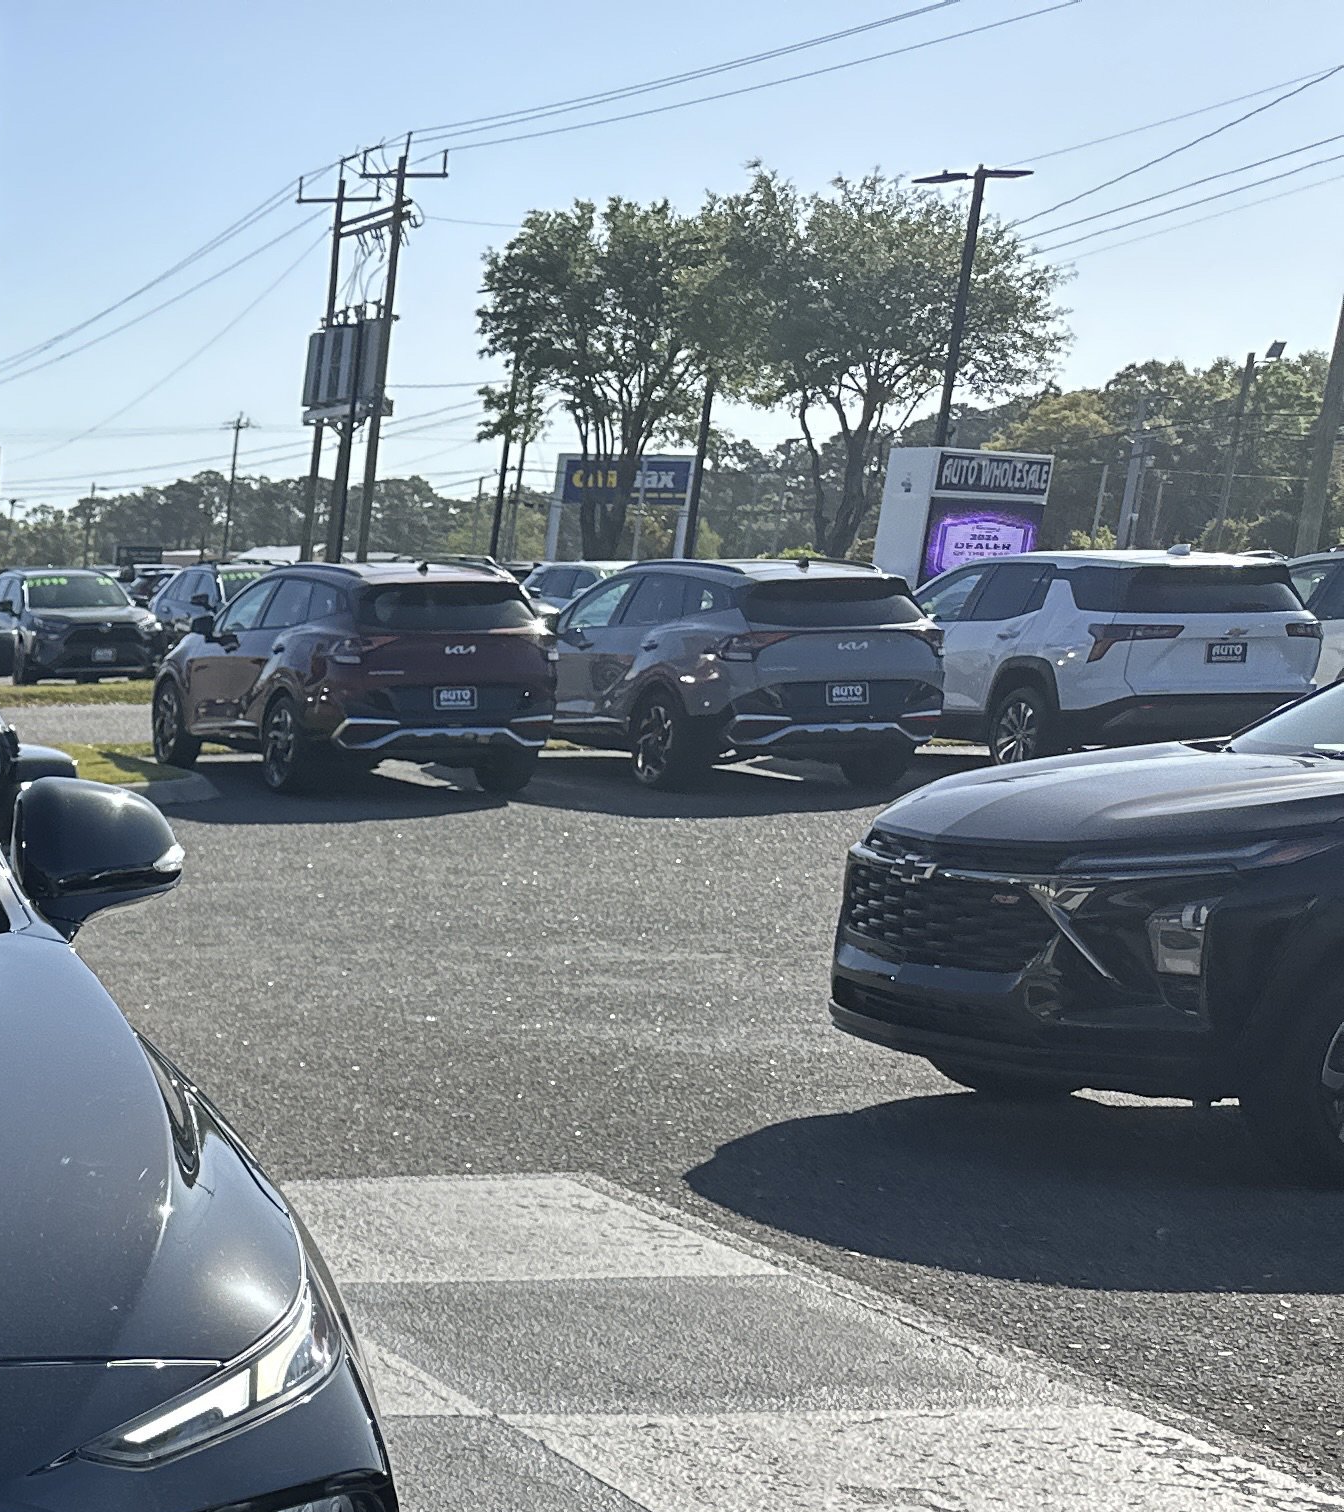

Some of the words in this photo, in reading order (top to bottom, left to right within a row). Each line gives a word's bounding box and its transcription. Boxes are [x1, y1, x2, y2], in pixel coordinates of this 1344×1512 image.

[942, 458, 978, 486] AUTO
[979, 460, 1049, 490] WHOLESALE
[954, 542, 1012, 550] DEALER
[1212, 645, 1243, 656] AUTO
[440, 689, 471, 701] AUTO
[832, 685, 863, 697] AUTO
